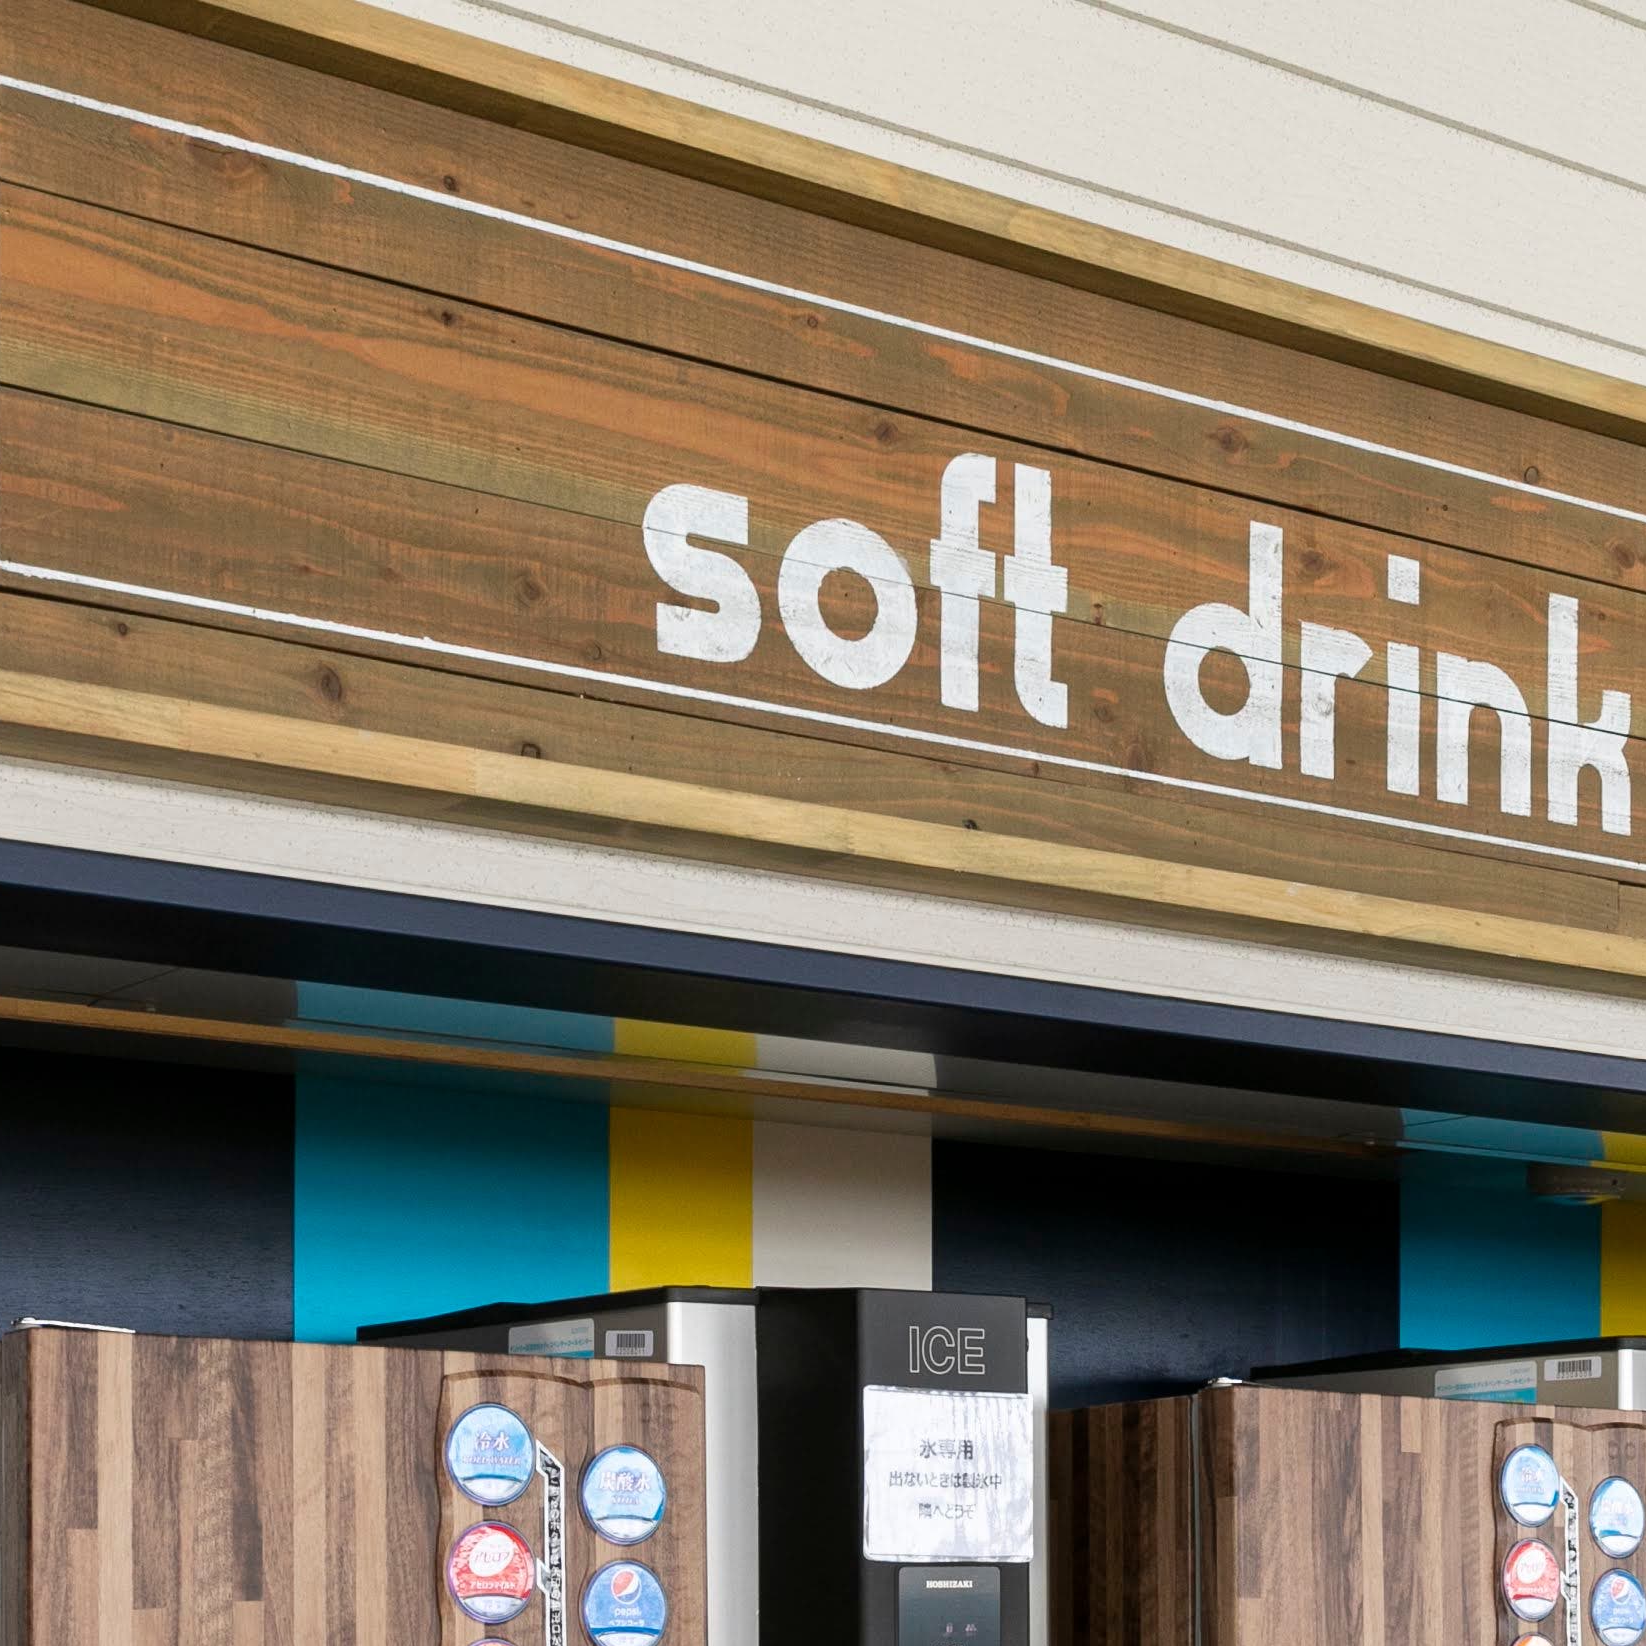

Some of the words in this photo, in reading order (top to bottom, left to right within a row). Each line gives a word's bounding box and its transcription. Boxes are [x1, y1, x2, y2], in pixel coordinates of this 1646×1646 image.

[642, 452, 1068, 729] soft
[1162, 519, 1632, 836] drink
[909, 1325, 986, 1375] ICE
[475, 1430, 510, 1450] 冷水
[919, 1439, 975, 1460] 氷専用
[599, 1471, 651, 1493] 炭酸水
